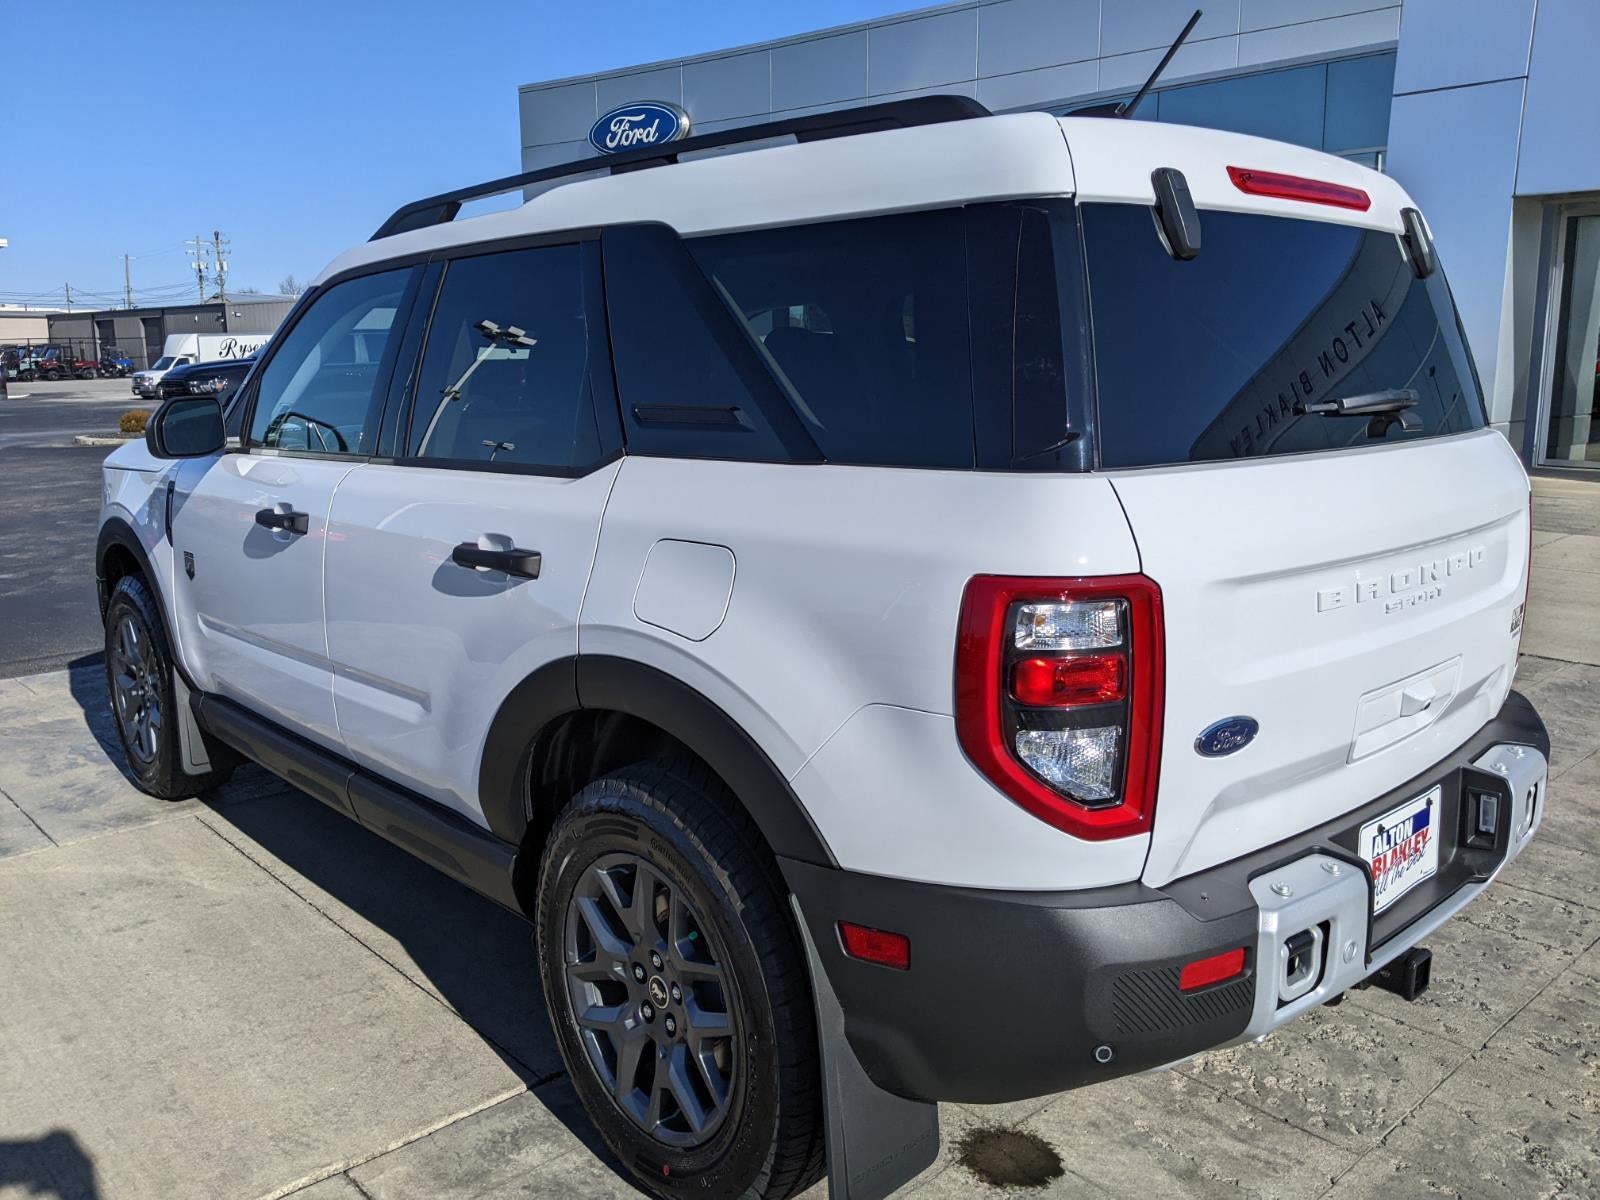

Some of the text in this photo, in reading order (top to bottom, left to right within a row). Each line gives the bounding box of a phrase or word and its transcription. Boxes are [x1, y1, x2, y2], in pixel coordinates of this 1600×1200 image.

[605, 114, 660, 148] Ford
[1316, 546, 1486, 613] BRONCO
[1384, 585, 1446, 614] SPORT
[1371, 827, 1430, 881] BLAKLEY
[1373, 817, 1413, 857] ALTON
